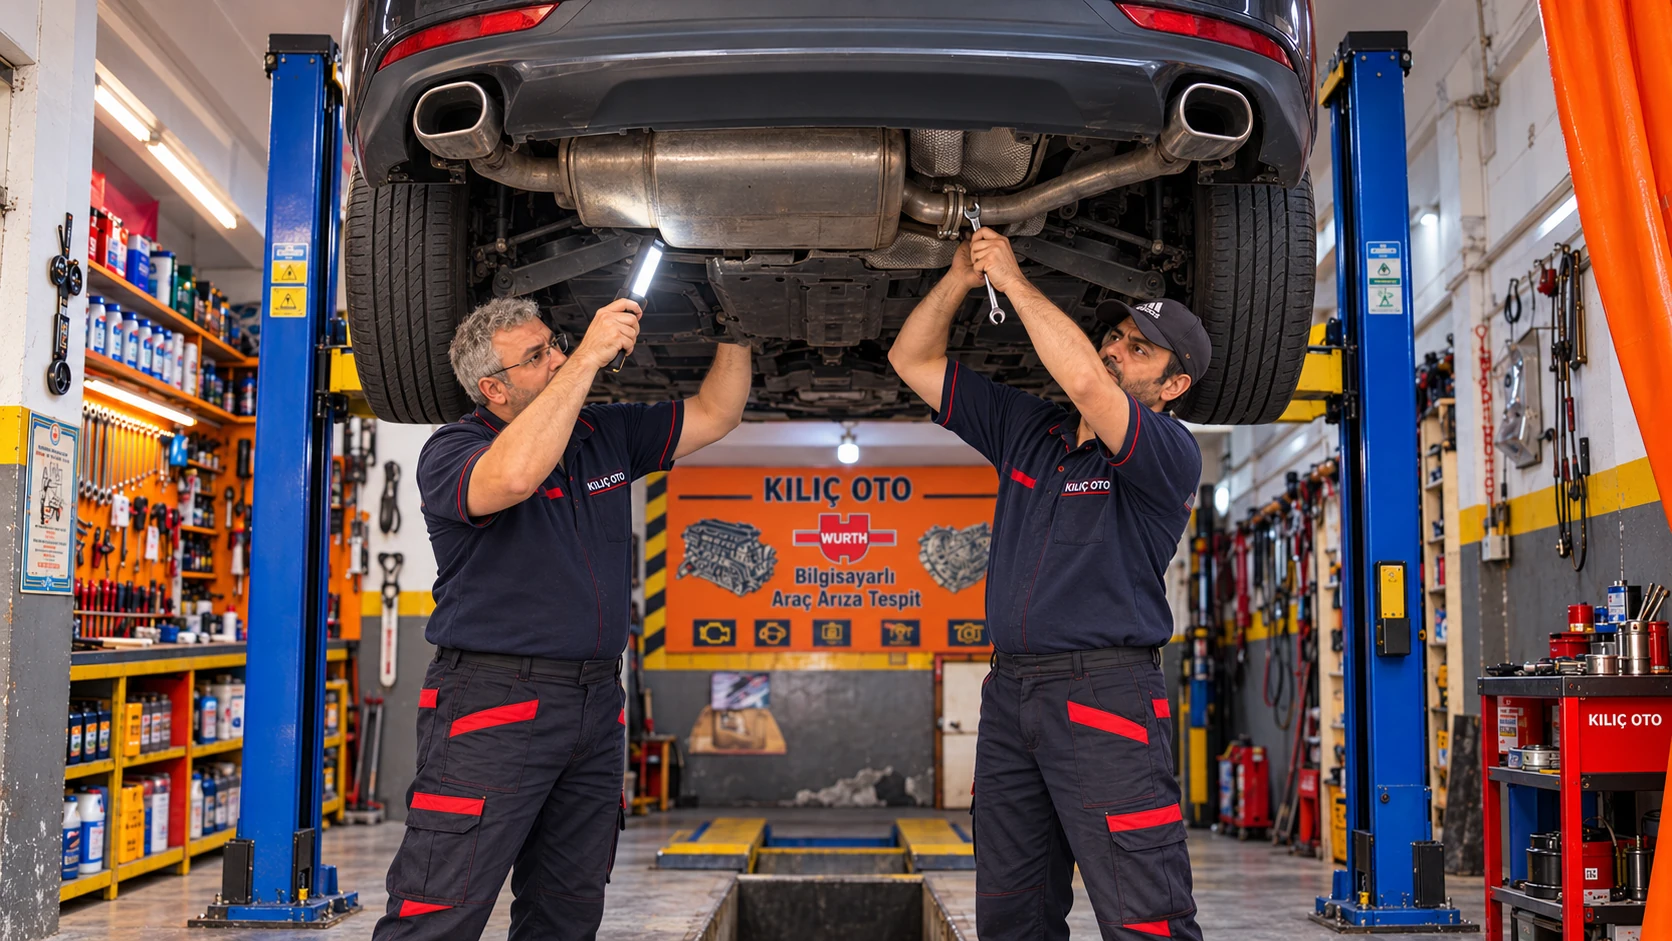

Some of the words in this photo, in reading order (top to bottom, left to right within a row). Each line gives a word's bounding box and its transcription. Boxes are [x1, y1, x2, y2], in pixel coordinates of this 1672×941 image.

[587, 477, 610, 491] KILIÇ
[610, 472, 625, 483] OTO
[1065, 481, 1089, 492] KILIÇ
[1090, 480, 1110, 490] OTO
[764, 476, 841, 508] KILIÇ
[851, 476, 912, 502] OTO
[821, 532, 868, 544] WURTH
[795, 567, 895, 588] Bilgisayarlı
[771, 590, 812, 611] Araç
[817, 590, 862, 607] Arıza
[868, 590, 921, 611] Tespit
[1588, 713, 1627, 729] KILIÇ
[1631, 713, 1662, 726] OTO
